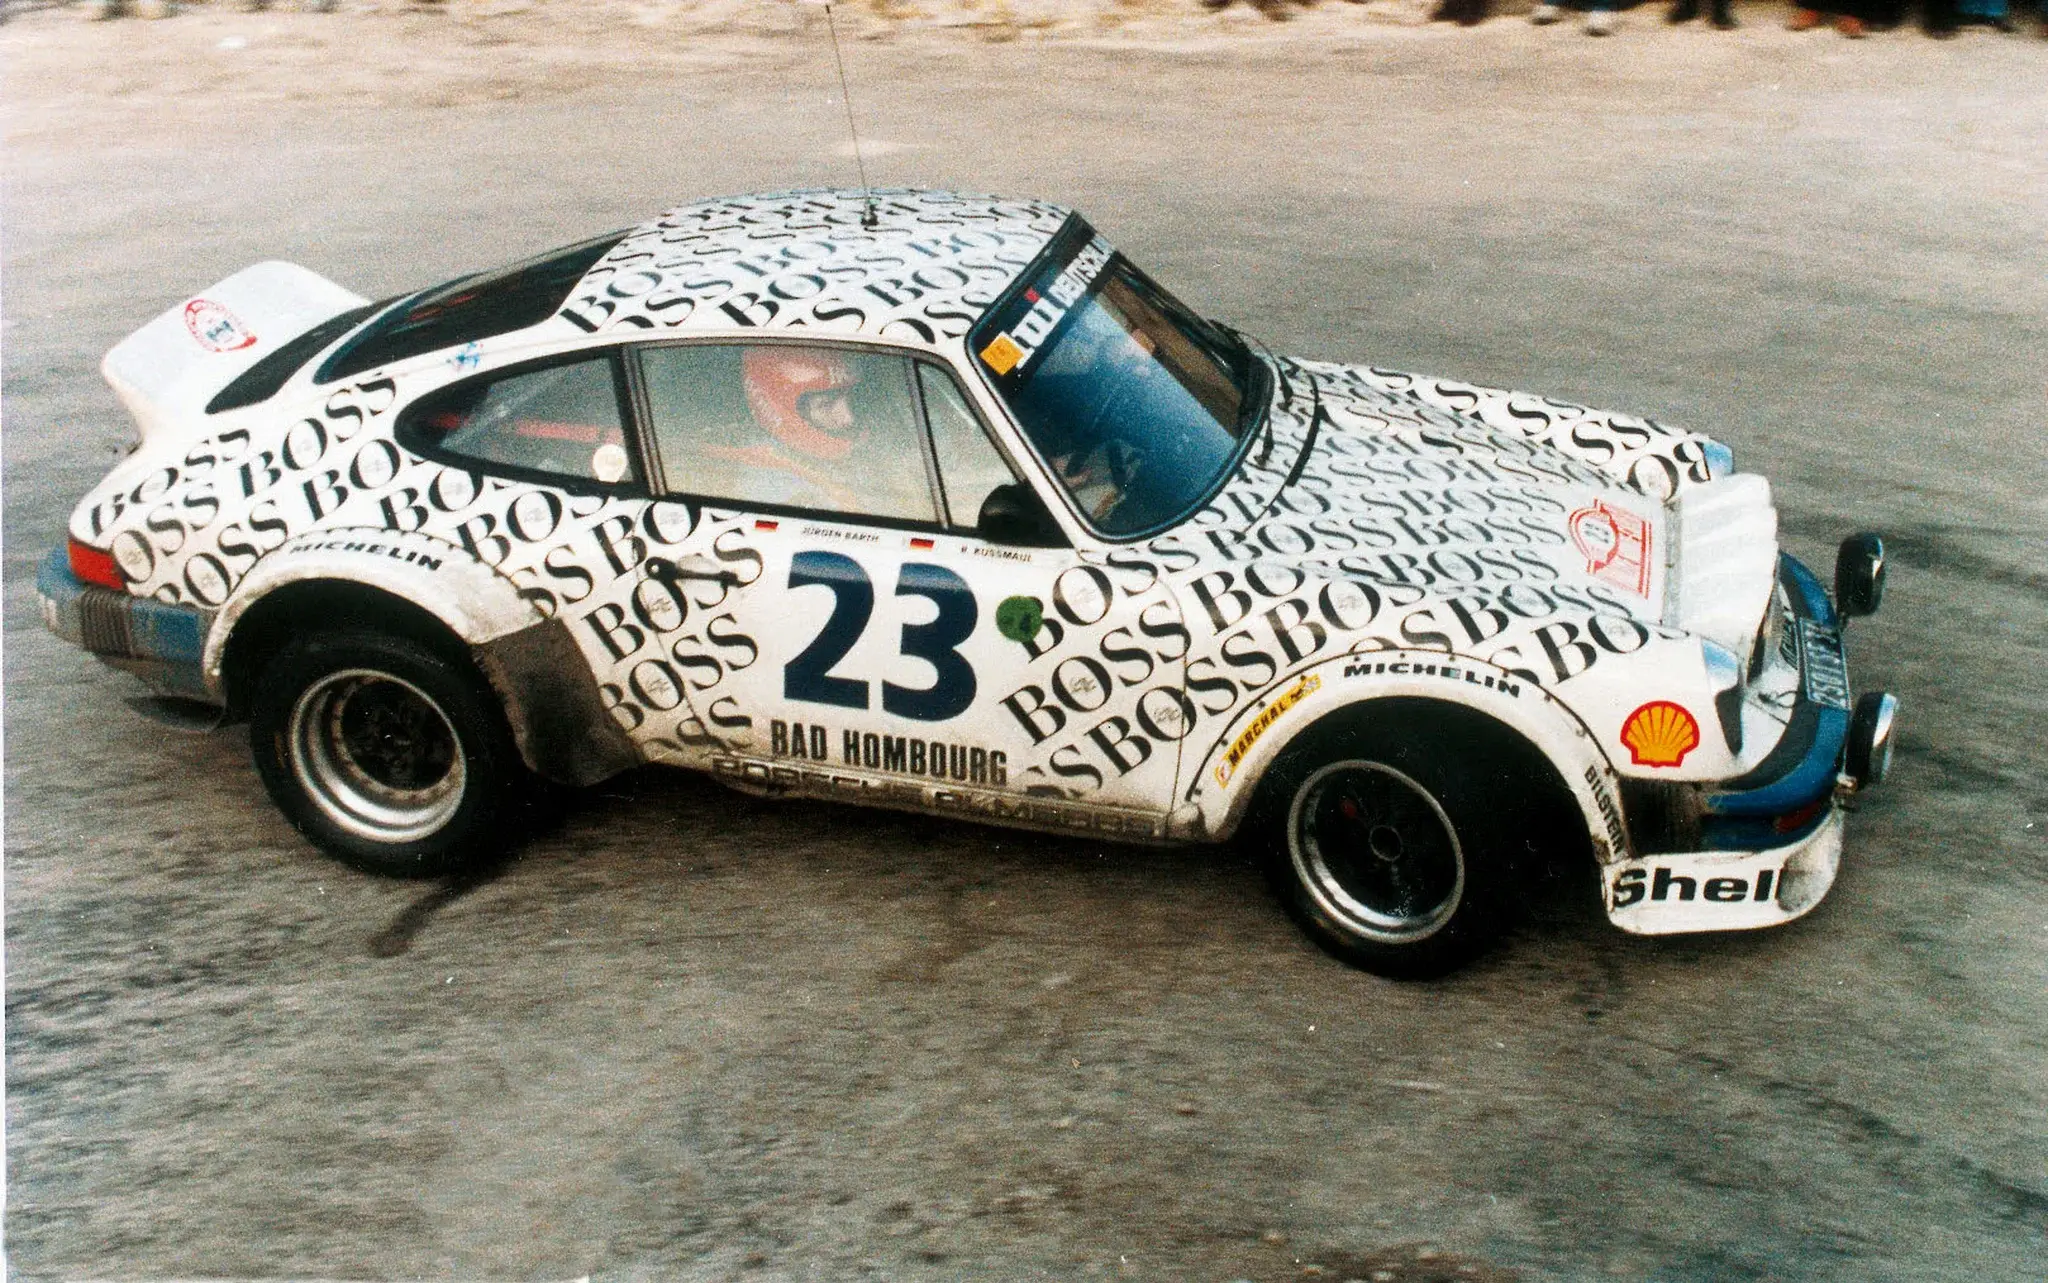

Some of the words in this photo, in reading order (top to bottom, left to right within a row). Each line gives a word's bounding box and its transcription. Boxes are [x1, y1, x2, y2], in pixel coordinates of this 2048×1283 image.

[238, 376, 397, 499] BOSS
[289, 541, 443, 572] MICHELIN
[783, 549, 979, 722] 23
[998, 600, 1192, 746] BOSS
[1083, 630, 1277, 778] BOSS
[1343, 661, 1520, 698] MICHELIN
[770, 719, 827, 762] BAD
[843, 728, 1008, 786] HOMBOURG
[1229, 702, 1288, 768] MARCHAL
[1583, 764, 1627, 855] BILSTEIN
[1612, 867, 1785, 908] Shel
